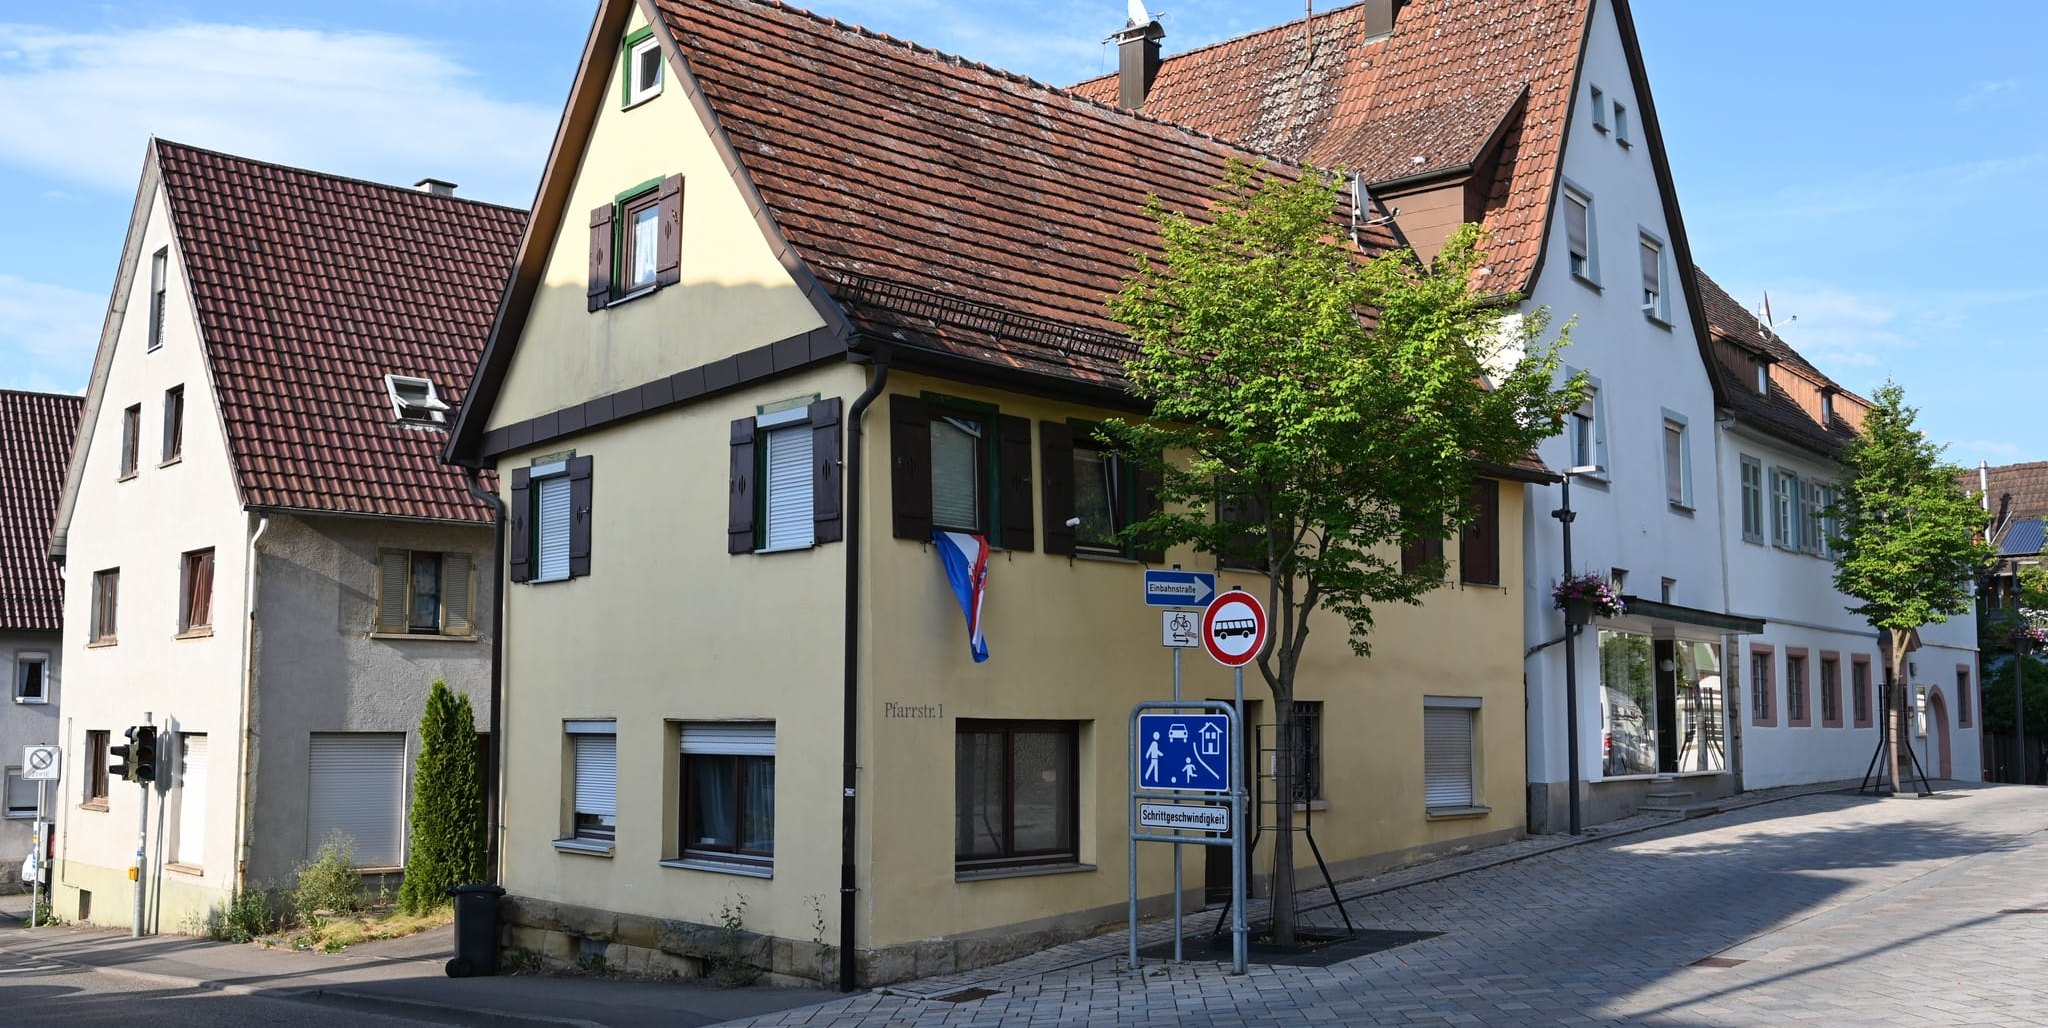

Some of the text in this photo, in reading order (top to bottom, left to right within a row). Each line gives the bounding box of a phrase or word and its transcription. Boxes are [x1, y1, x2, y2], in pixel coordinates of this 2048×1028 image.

[1149, 583, 1196, 594] Einbahnstraße
[885, 702, 944, 718] Pfarrstr. 1
[1142, 809, 1225, 827] Schrittgeschwindigkeit
